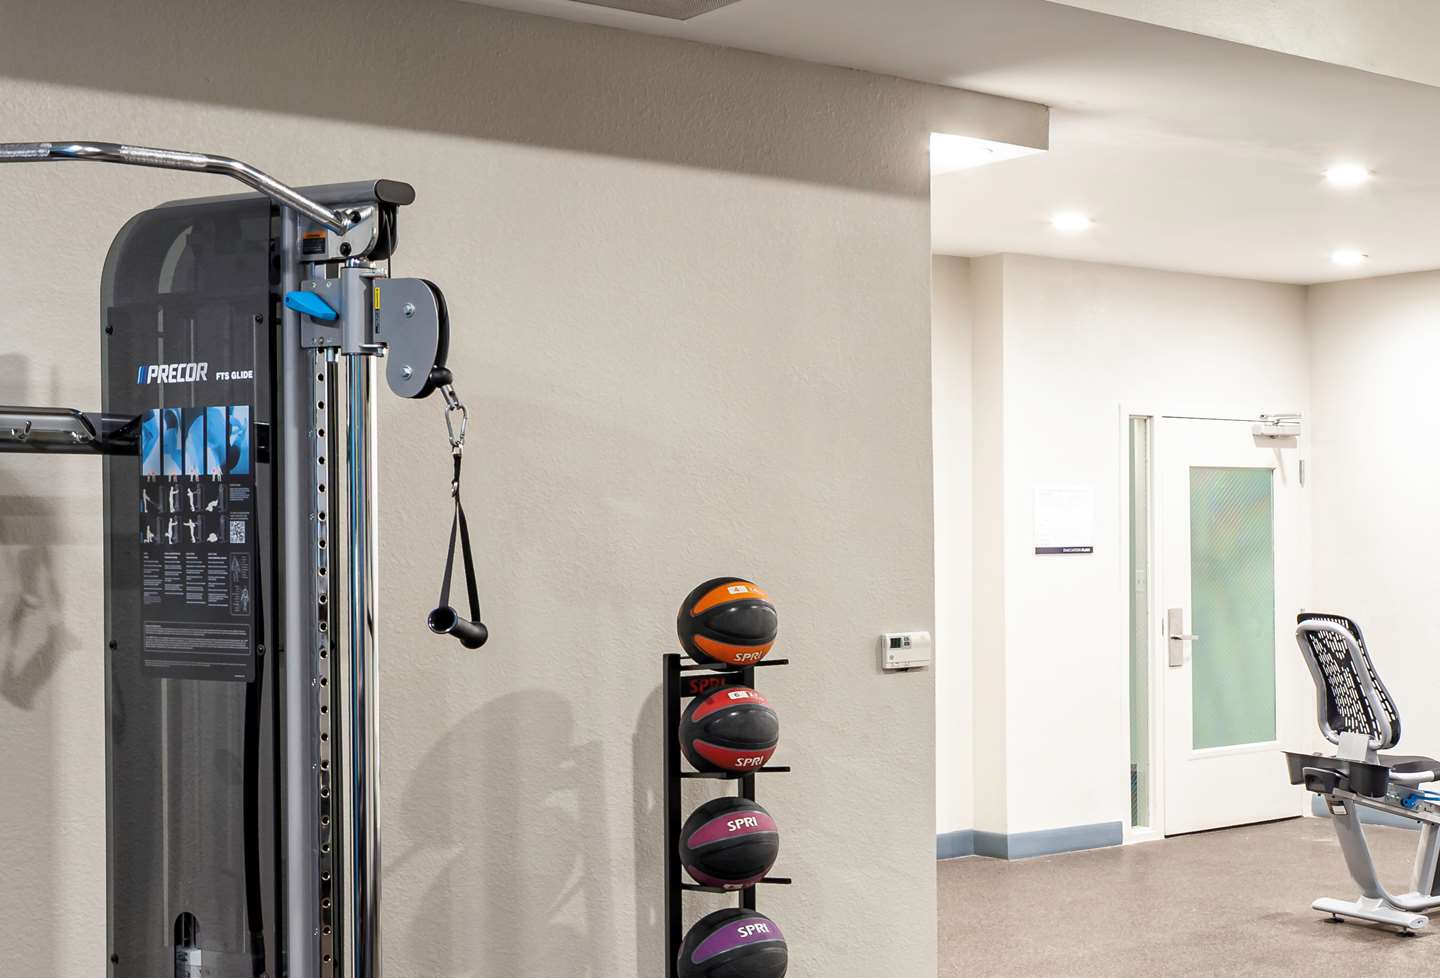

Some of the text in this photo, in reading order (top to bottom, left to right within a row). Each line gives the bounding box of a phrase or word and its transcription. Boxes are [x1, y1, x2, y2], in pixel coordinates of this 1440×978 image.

[147, 362, 209, 385] PRECOR
[216, 370, 253, 381] FTS GLIDE
[734, 651, 763, 662] SPRI
[735, 755, 764, 767] SPRI
[727, 816, 758, 832] SPRI
[737, 922, 769, 938] SPRI
